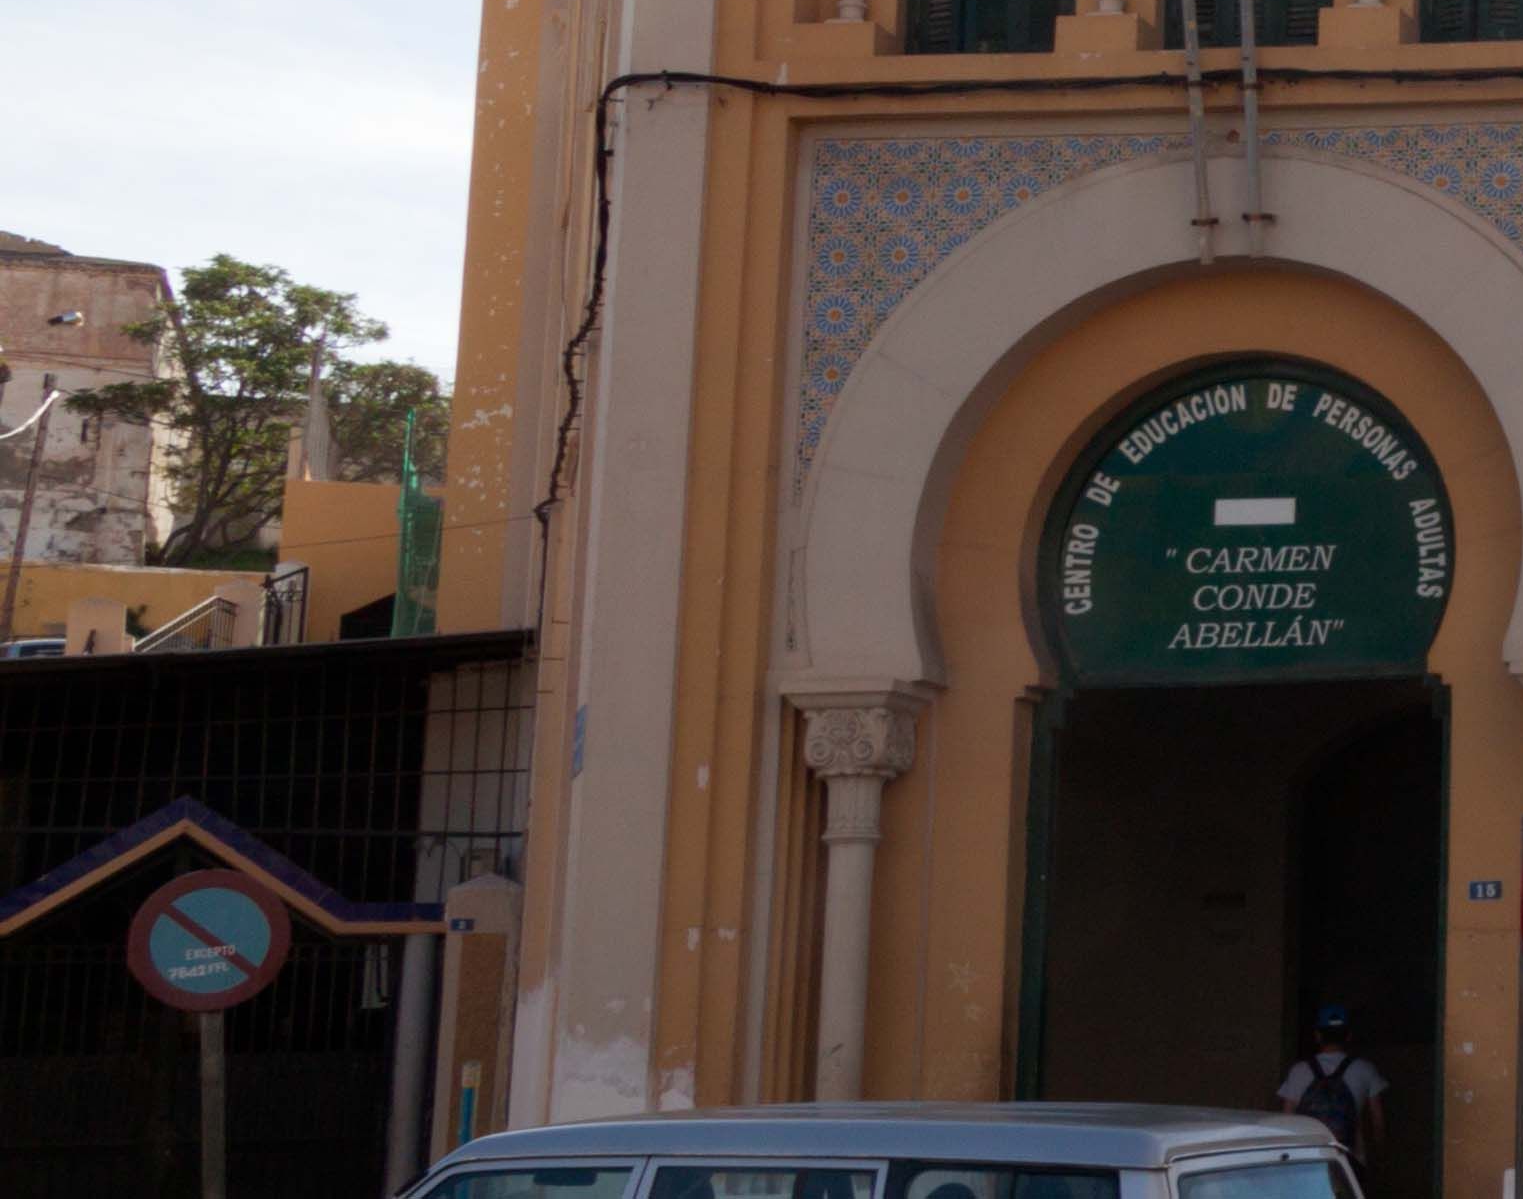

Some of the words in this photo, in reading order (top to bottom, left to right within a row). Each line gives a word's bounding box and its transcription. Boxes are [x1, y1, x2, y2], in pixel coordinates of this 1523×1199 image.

[1064, 523, 1099, 615] CENTRO
[1086, 471, 1121, 506] DE
[1118, 384, 1247, 465] EDUCACIÓN
[1267, 383, 1298, 411] DE
[1312, 393, 1418, 481] PERSONAS
[1409, 498, 1448, 599] ADULTAS
[1186, 545, 1336, 573] CARMEN
[1193, 583, 1316, 611] CONDE
[1168, 616, 1344, 650] ABELLÁN"
[184, 945, 236, 961] EXCEPTO
